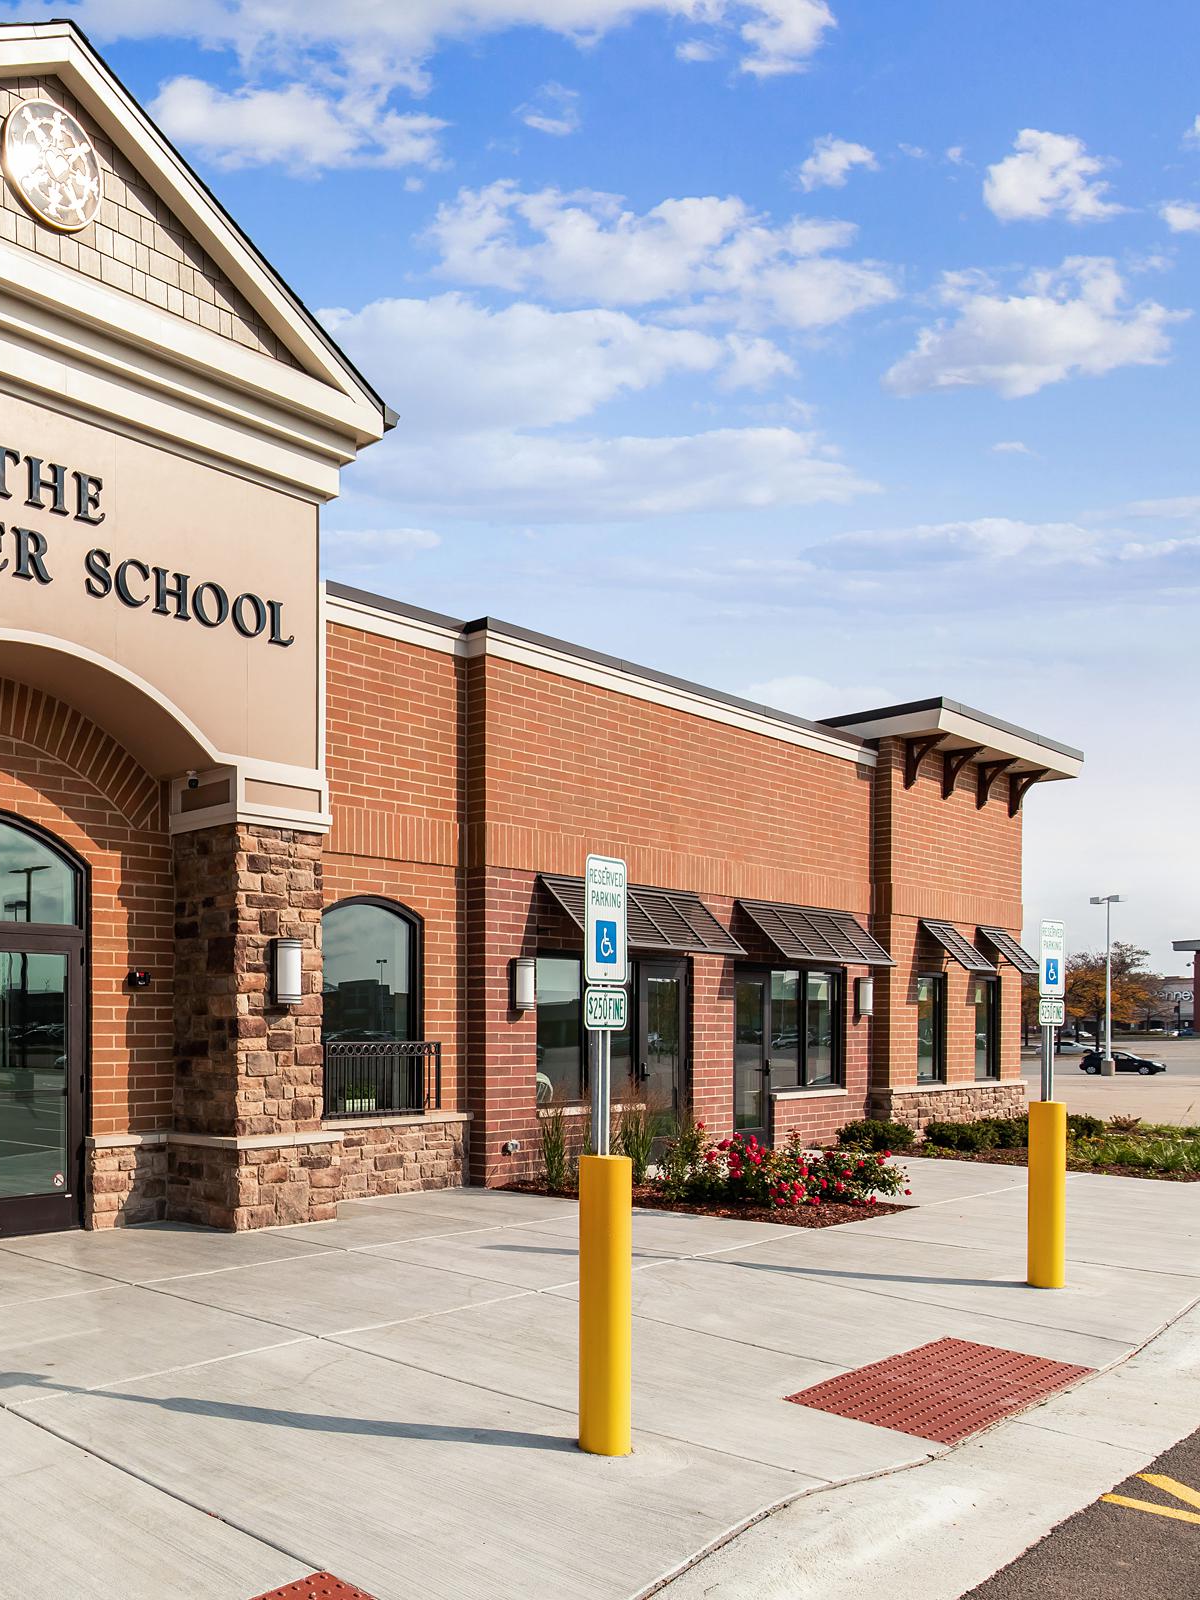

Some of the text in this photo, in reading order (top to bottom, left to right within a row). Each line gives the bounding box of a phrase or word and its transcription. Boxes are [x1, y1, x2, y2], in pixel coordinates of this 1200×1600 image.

[83, 547, 295, 647] SCHOOL
[589, 868, 623, 888] RESERVED
[591, 890, 622, 909] PARKING
[588, 996, 624, 1020] $250 FINE
